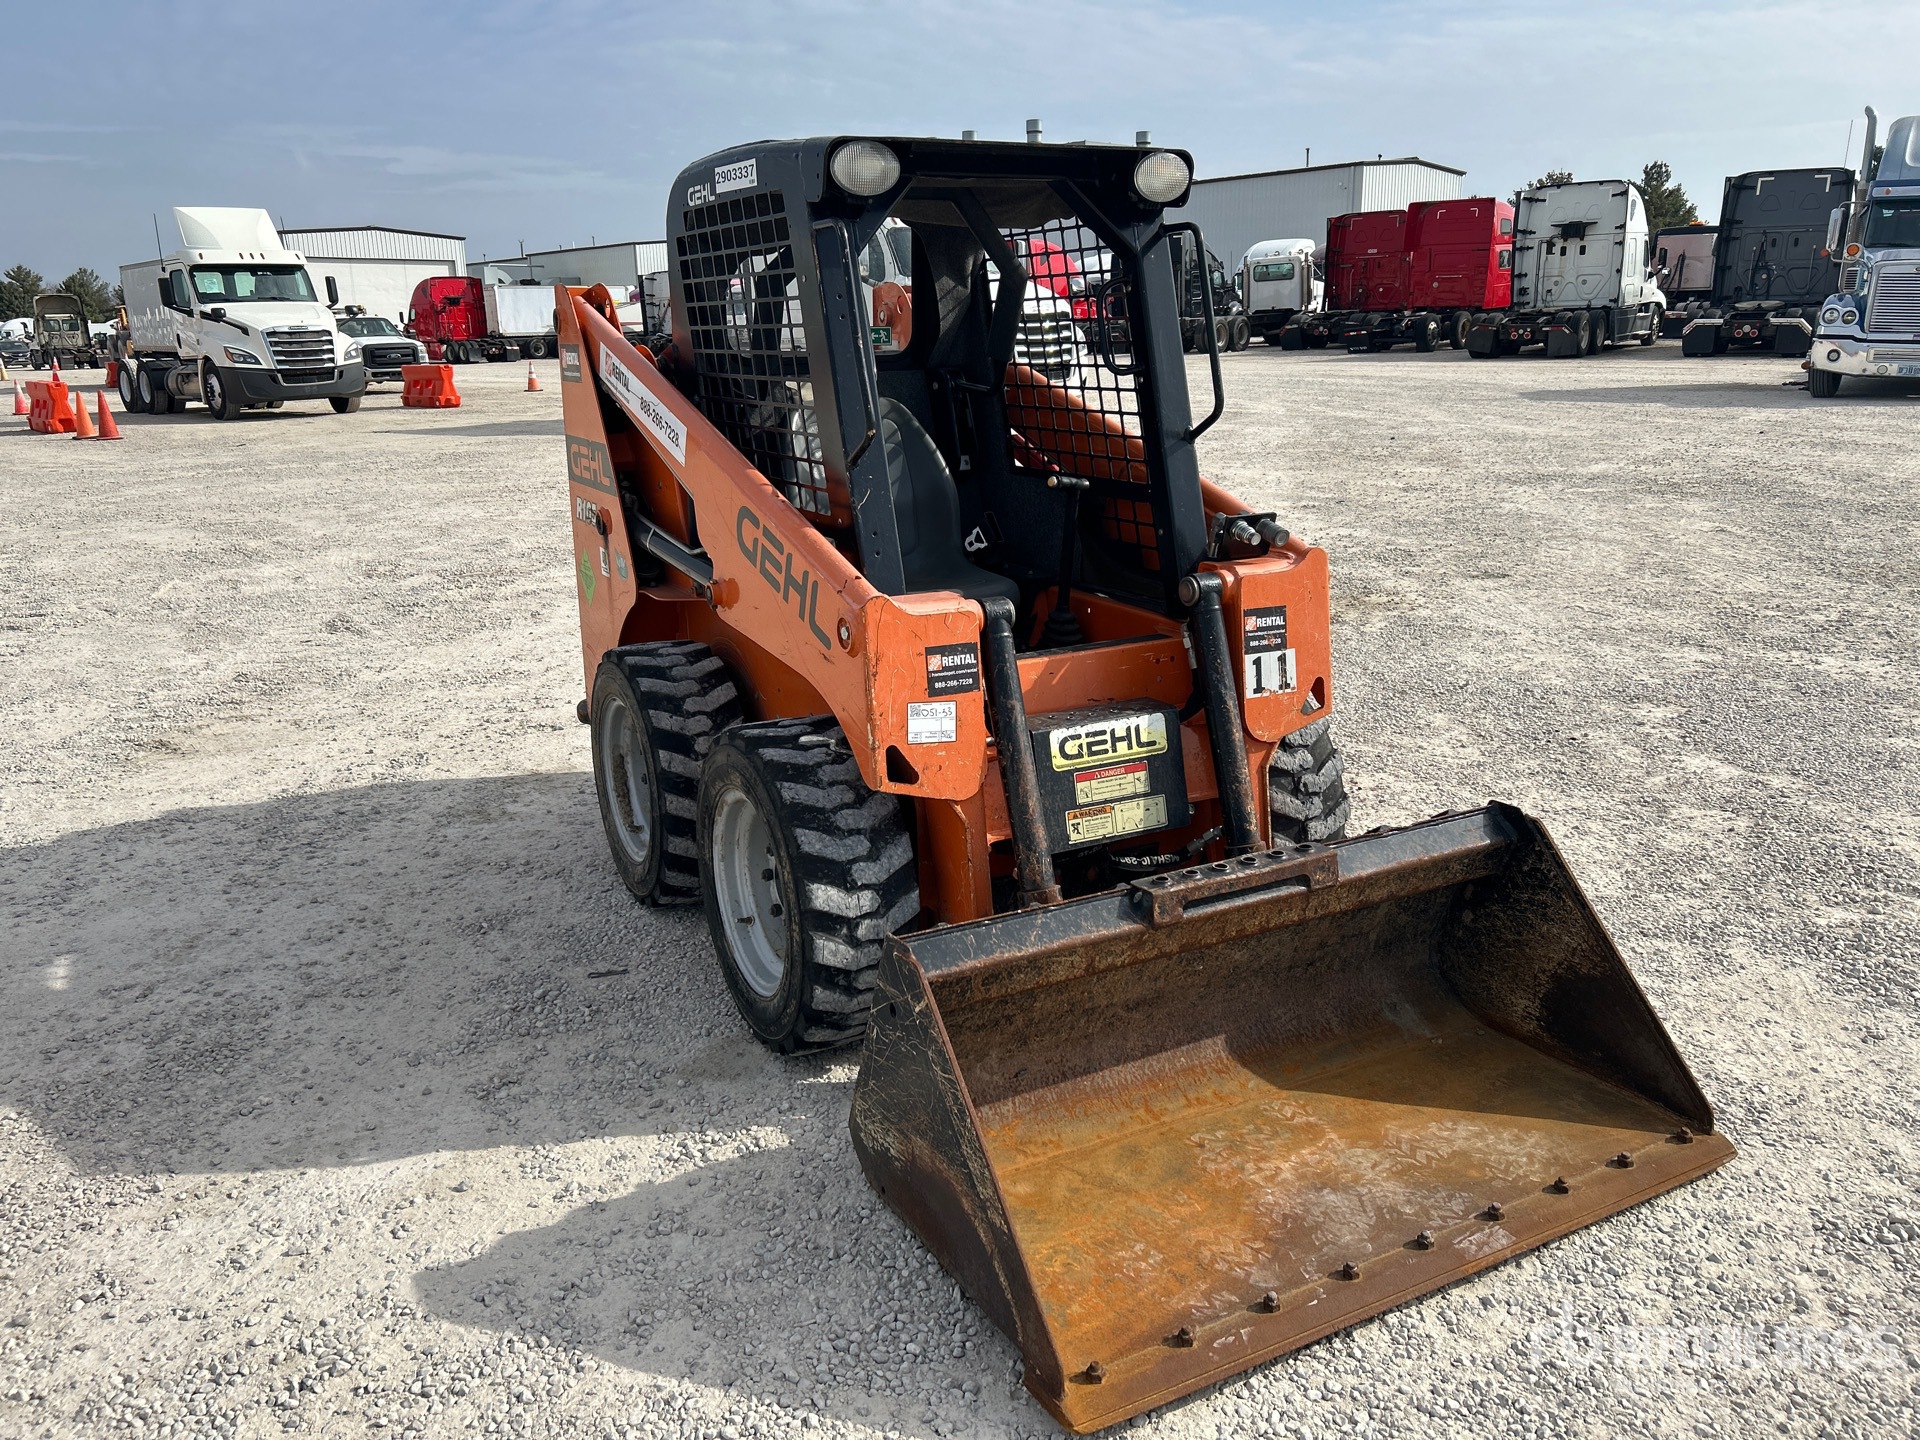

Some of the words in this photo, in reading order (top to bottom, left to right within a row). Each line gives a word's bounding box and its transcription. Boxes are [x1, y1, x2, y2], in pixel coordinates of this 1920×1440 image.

[715, 164, 755, 185] 2903337
[687, 182, 716, 207] GEHL
[612, 361, 631, 393] RENTAL
[639, 396, 681, 448] 888-266-7228
[570, 443, 611, 487] GEHL
[736, 505, 832, 651] GEHL
[1256, 616, 1286, 628] RENTAL
[942, 653, 977, 667] RENTAL
[1252, 652, 1291, 694] 11
[1058, 723, 1158, 761] GEHL
[1100, 767, 1126, 777] DANGER
